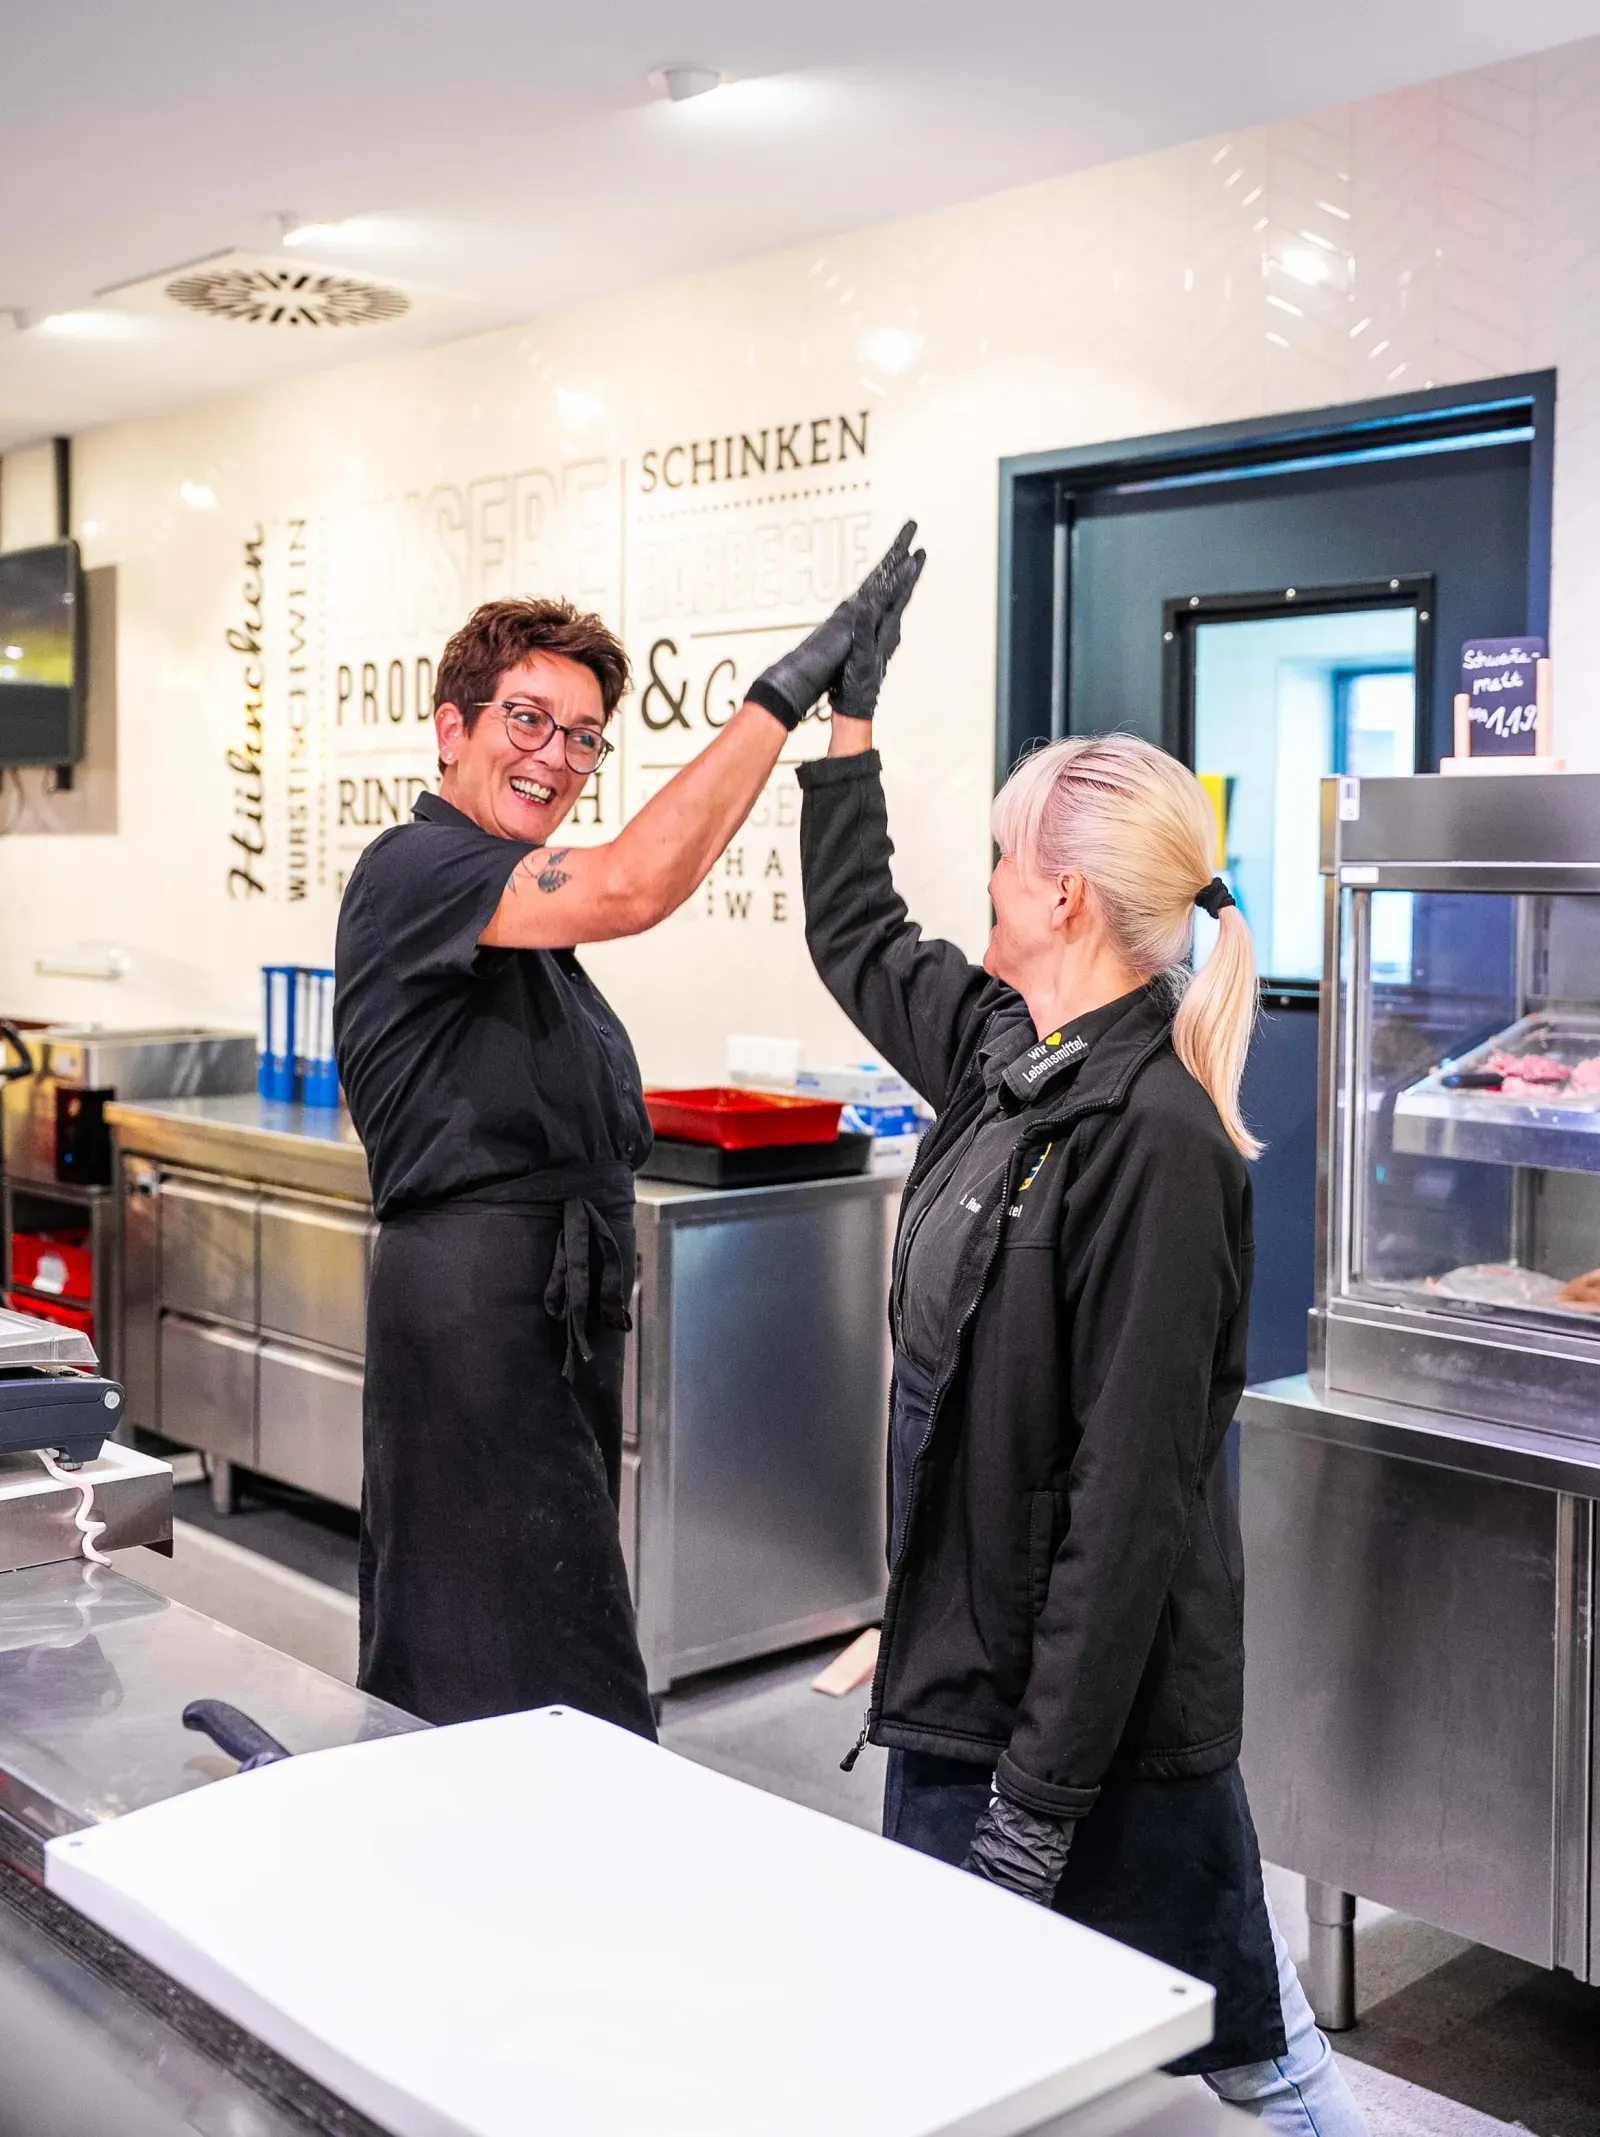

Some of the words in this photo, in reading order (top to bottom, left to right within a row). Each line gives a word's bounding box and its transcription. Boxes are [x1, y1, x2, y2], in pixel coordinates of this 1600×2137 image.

[640, 409, 871, 495] SCHINKEN
[340, 455, 608, 640] NSERE
[224, 521, 265, 902] Hühnchen
[1027, 1044, 1049, 1061] Wir
